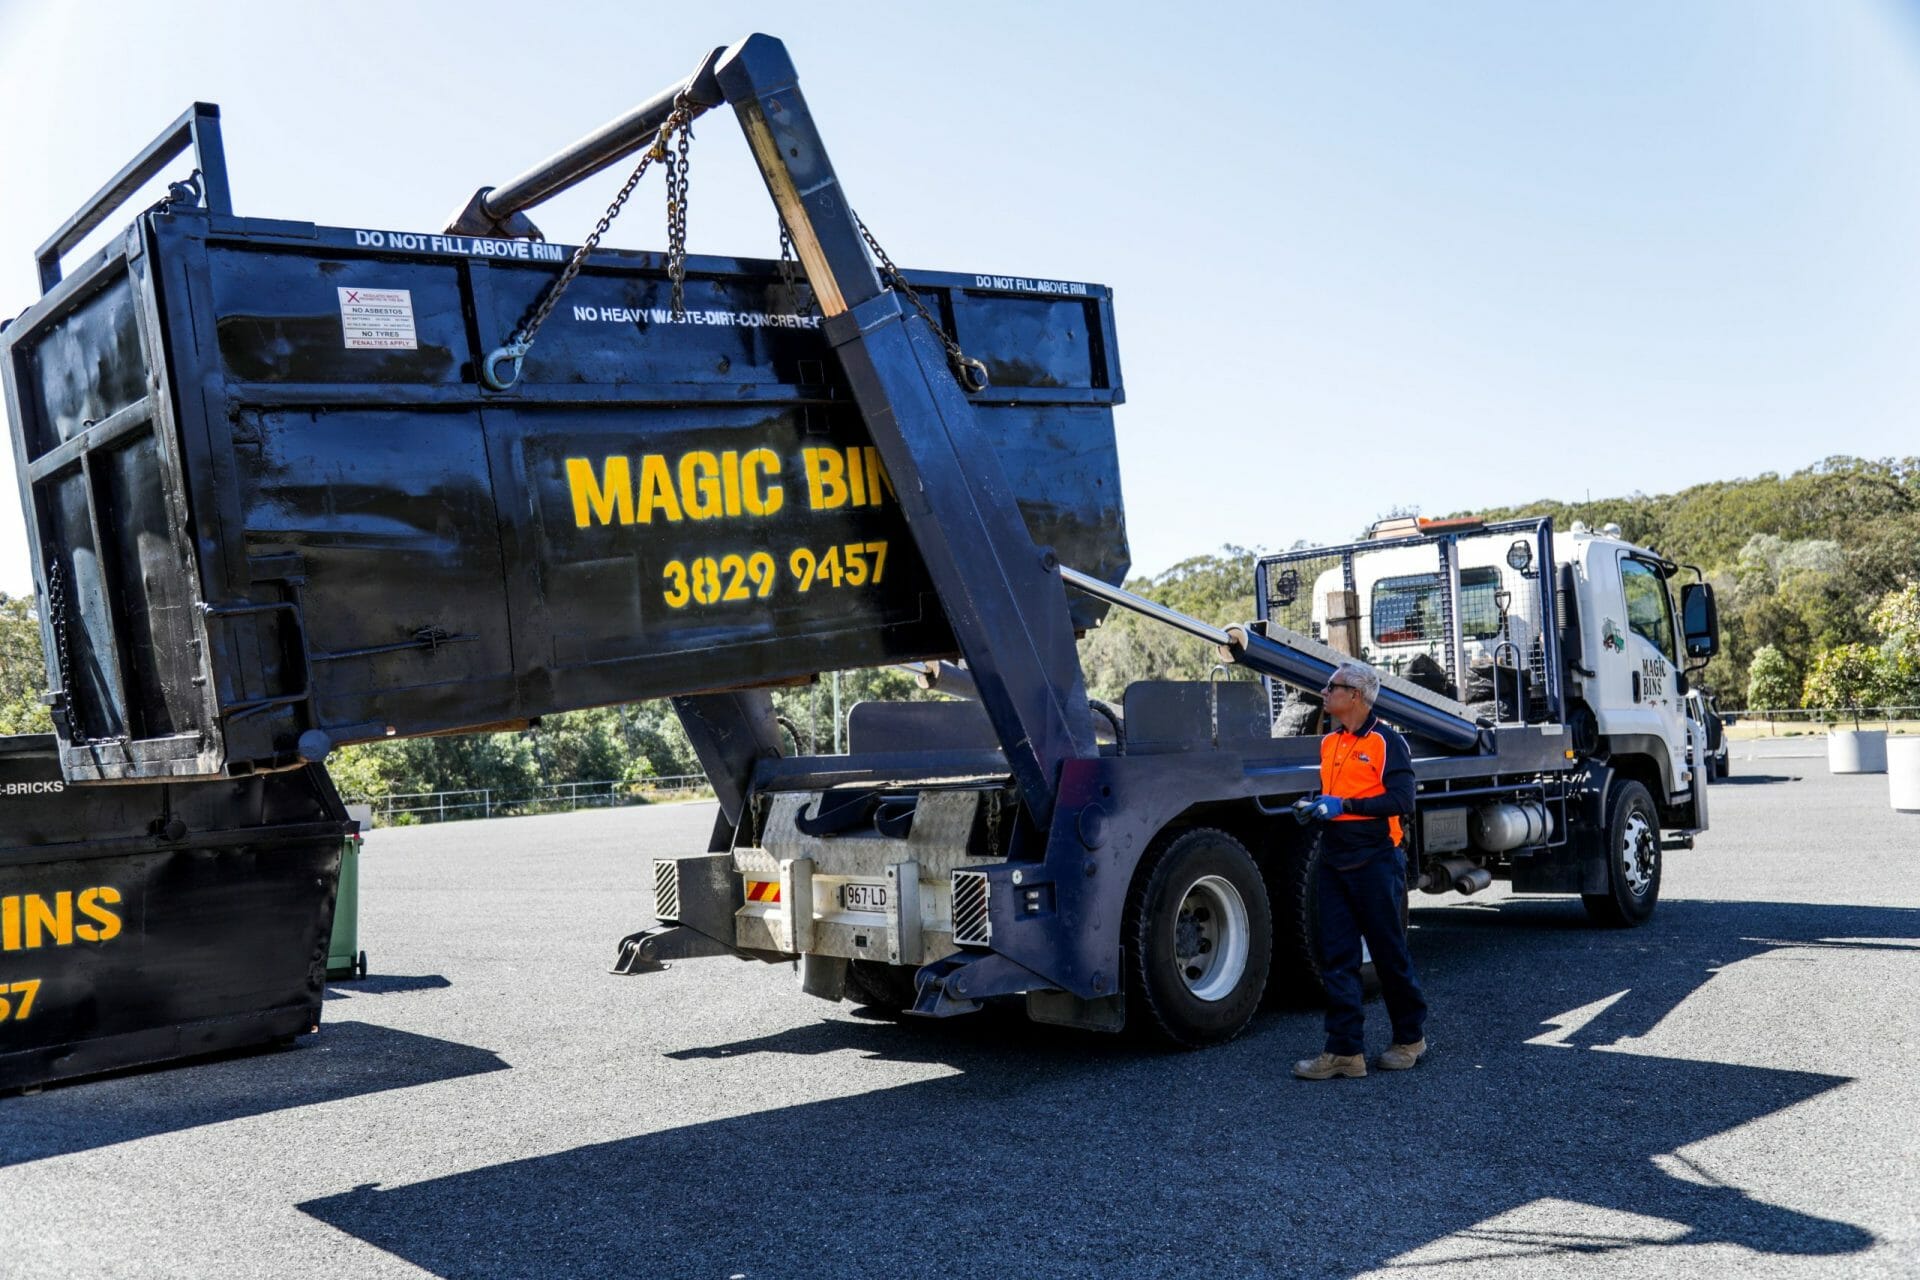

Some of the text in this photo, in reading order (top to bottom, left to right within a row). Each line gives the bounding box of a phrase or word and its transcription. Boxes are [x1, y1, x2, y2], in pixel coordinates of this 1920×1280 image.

[356, 230, 563, 261] DO NOT FILL ABOVE RIM
[976, 275, 1087, 295] DO NOT FILL ABOVE RIM
[573, 306, 597, 322] NO
[600, 307, 649, 323] HEAVY
[565, 446, 898, 529] MAGIC BIN
[663, 541, 889, 609] 3829 9457
[1641, 658, 1667, 678] MAGIC
[1643, 678, 1663, 696] BINS
[2, 886, 122, 951] INS
